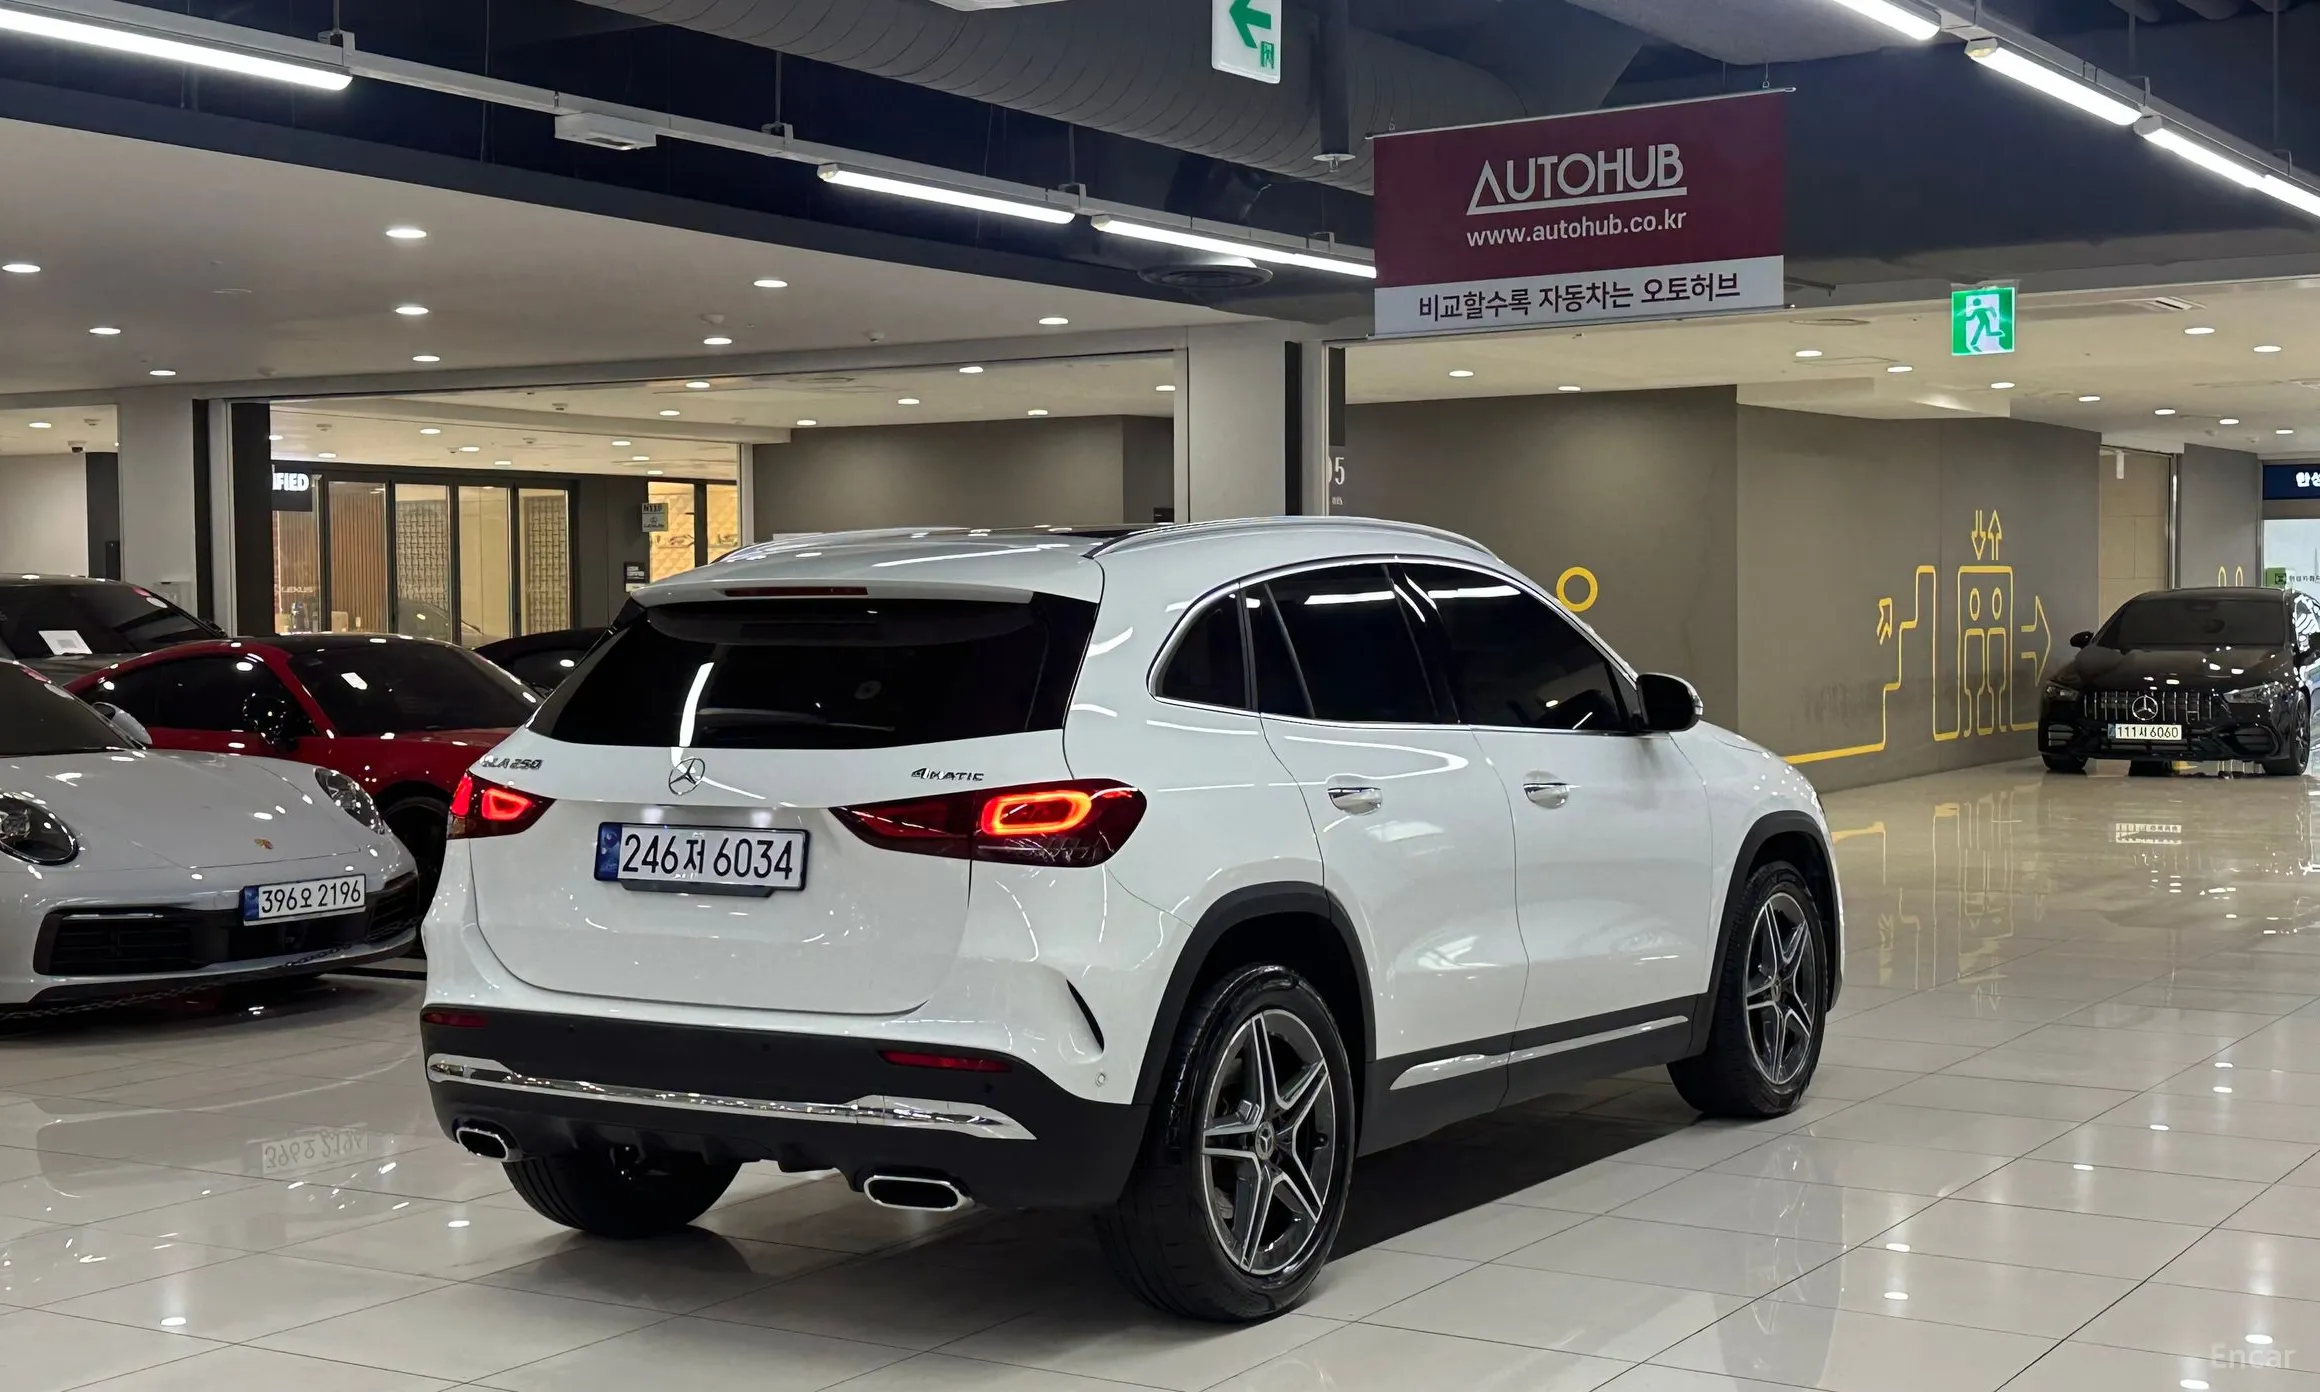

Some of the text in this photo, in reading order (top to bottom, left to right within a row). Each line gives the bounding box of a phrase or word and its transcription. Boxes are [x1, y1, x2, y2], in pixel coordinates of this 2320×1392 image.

[1467, 143, 1687, 215] AUTOHUB
[1467, 208, 1687, 247] www.autohub.co.kr
[1419, 272, 1740, 321] 비교할수록 자동차는 오토허브
[622, 833, 793, 880] 246저 6034
[261, 880, 361, 914] 396오 2196
